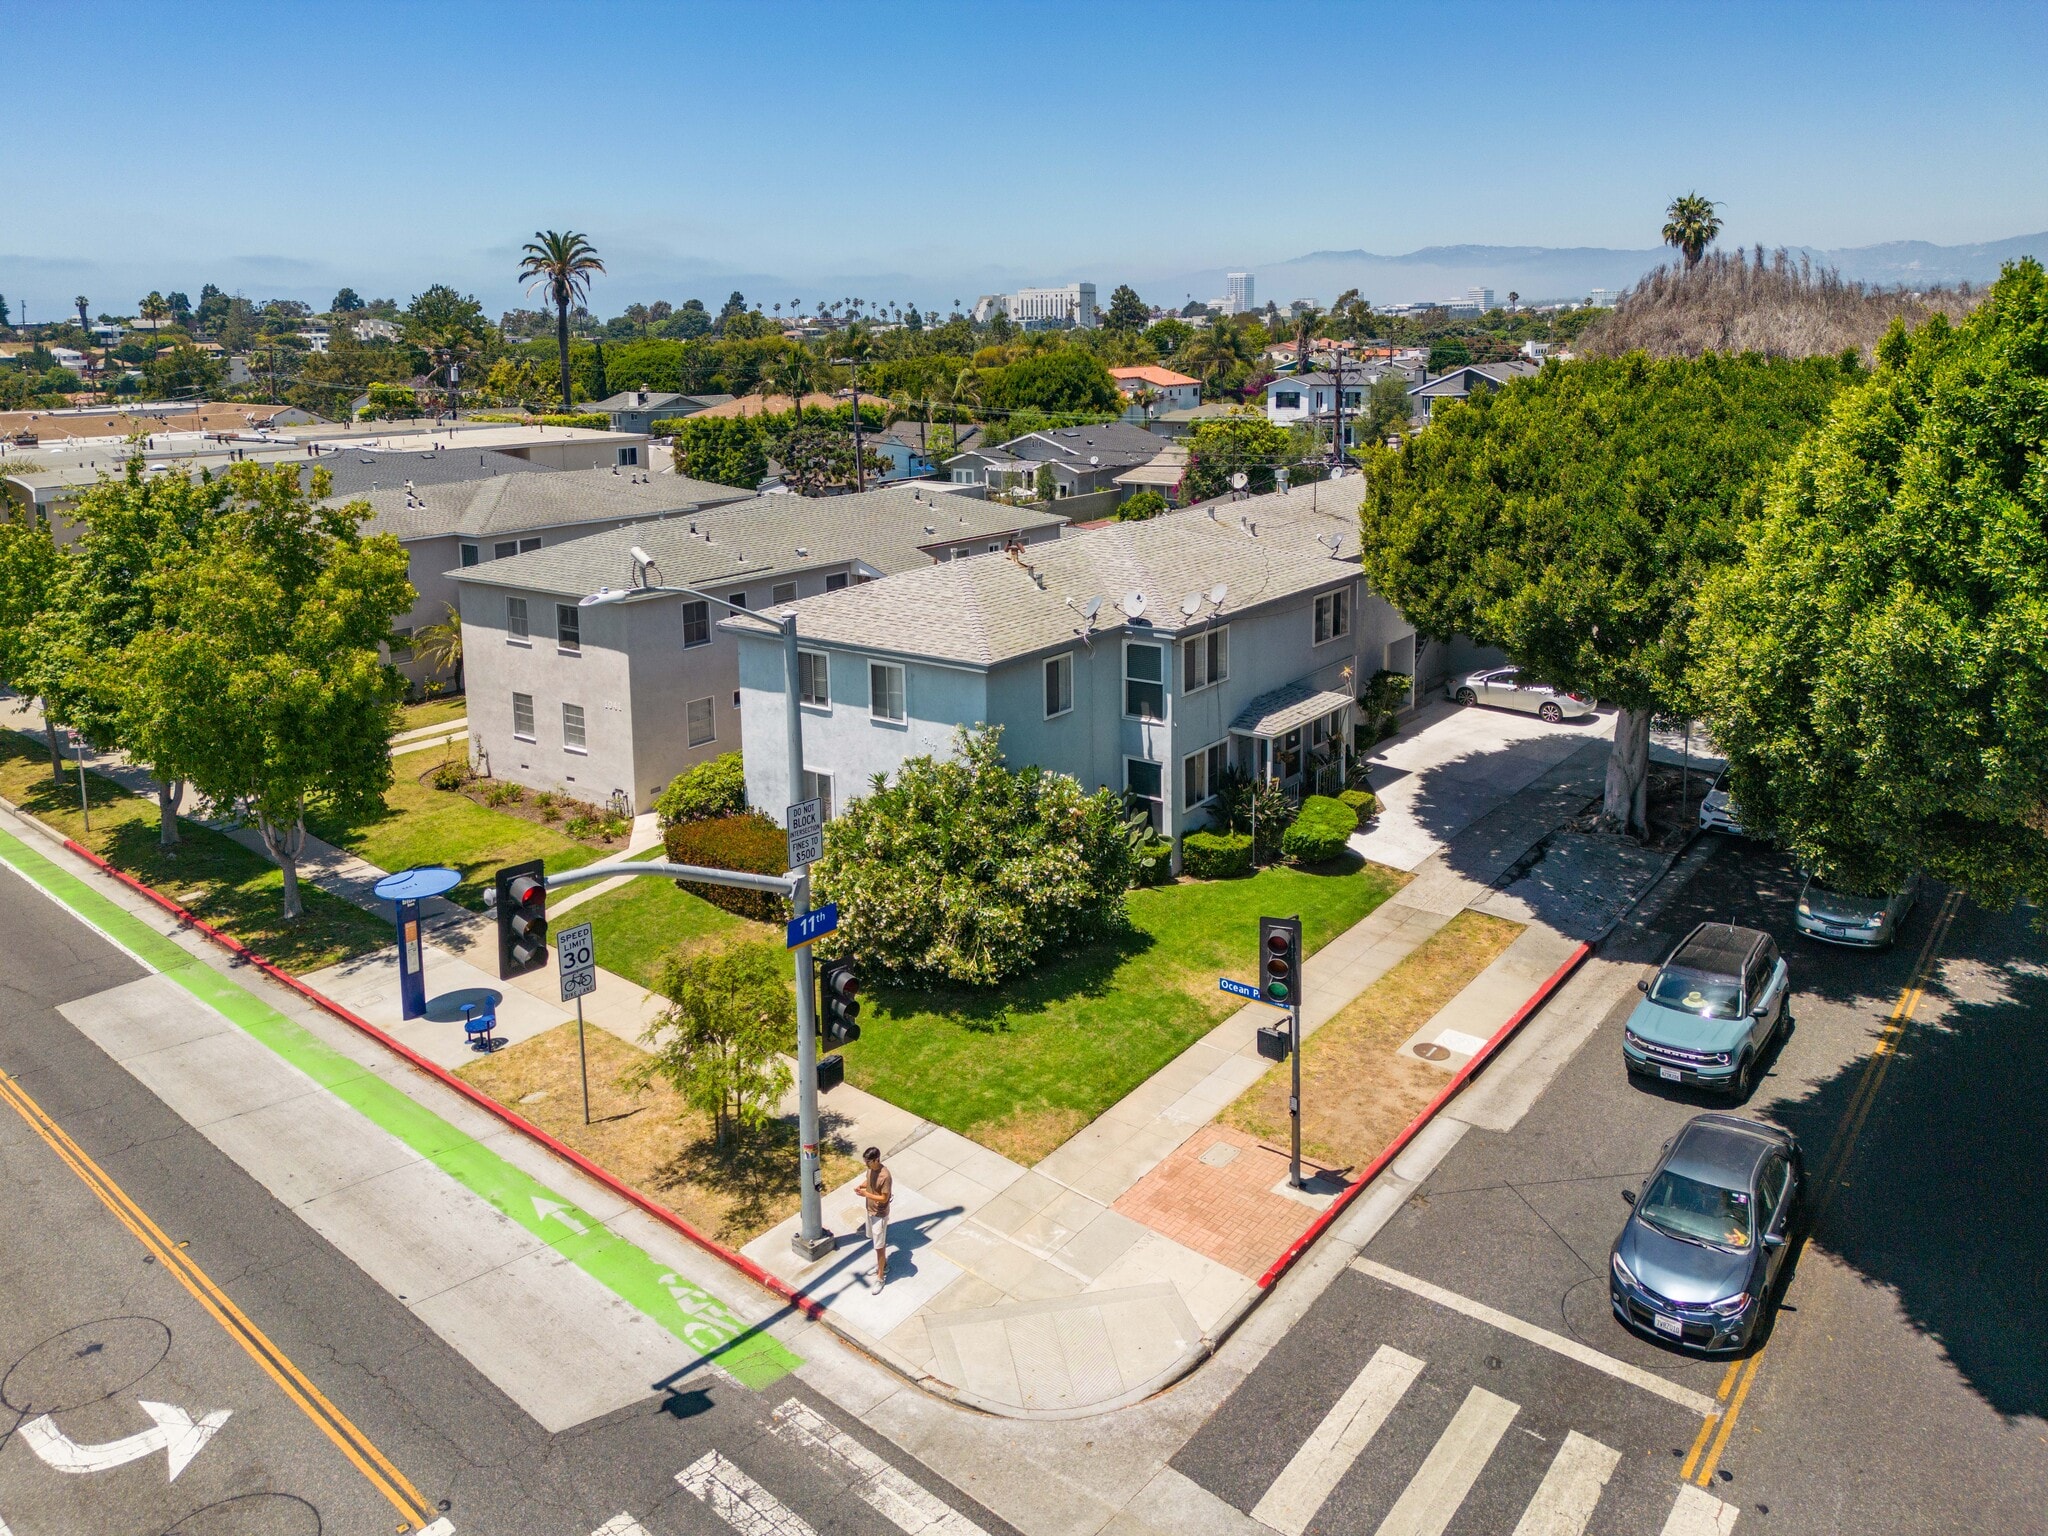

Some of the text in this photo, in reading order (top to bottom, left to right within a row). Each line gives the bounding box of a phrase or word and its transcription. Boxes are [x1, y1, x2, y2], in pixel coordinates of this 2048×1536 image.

[793, 803, 815, 817] DO NOT
[793, 813, 816, 829] BLOCK
[790, 824, 820, 838] INTERSECTION
[792, 836, 819, 852] FINES TO
[796, 847, 816, 862] $500
[800, 912, 825, 936] 11th
[560, 928, 589, 944] SPEED
[564, 938, 586, 952] LIMIT
[563, 947, 590, 969] 30
[565, 985, 593, 1000] BIKE LANE
[1221, 979, 1250, 996] Ocean
